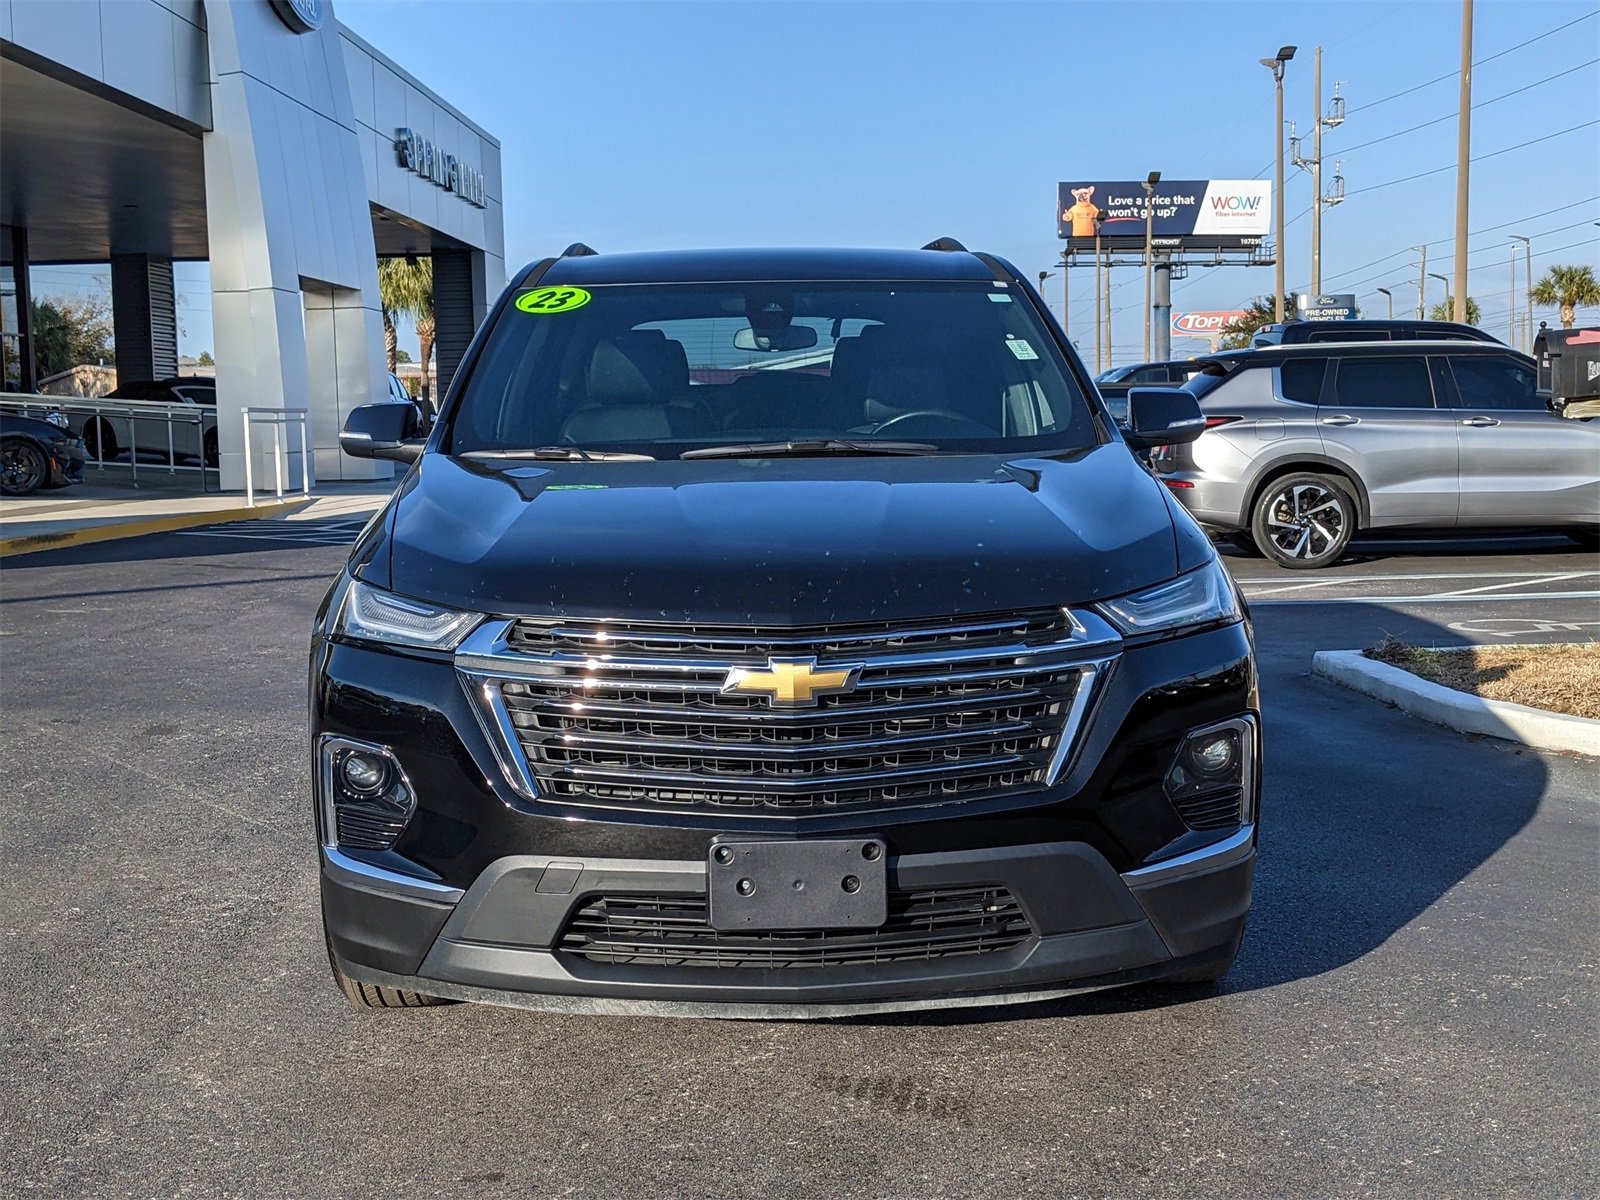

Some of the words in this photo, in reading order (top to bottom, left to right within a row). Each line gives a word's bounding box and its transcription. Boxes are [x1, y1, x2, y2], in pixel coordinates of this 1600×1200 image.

[397, 128, 458, 192] SPRING
[1108, 195, 1133, 206] Love
[1135, 197, 1142, 205] a
[1173, 195, 1195, 205] that
[1211, 196, 1261, 210] WOW!
[1108, 207, 1139, 217] won't
[527, 290, 576, 309] 23
[1305, 308, 1349, 317] PRE-OWNED
